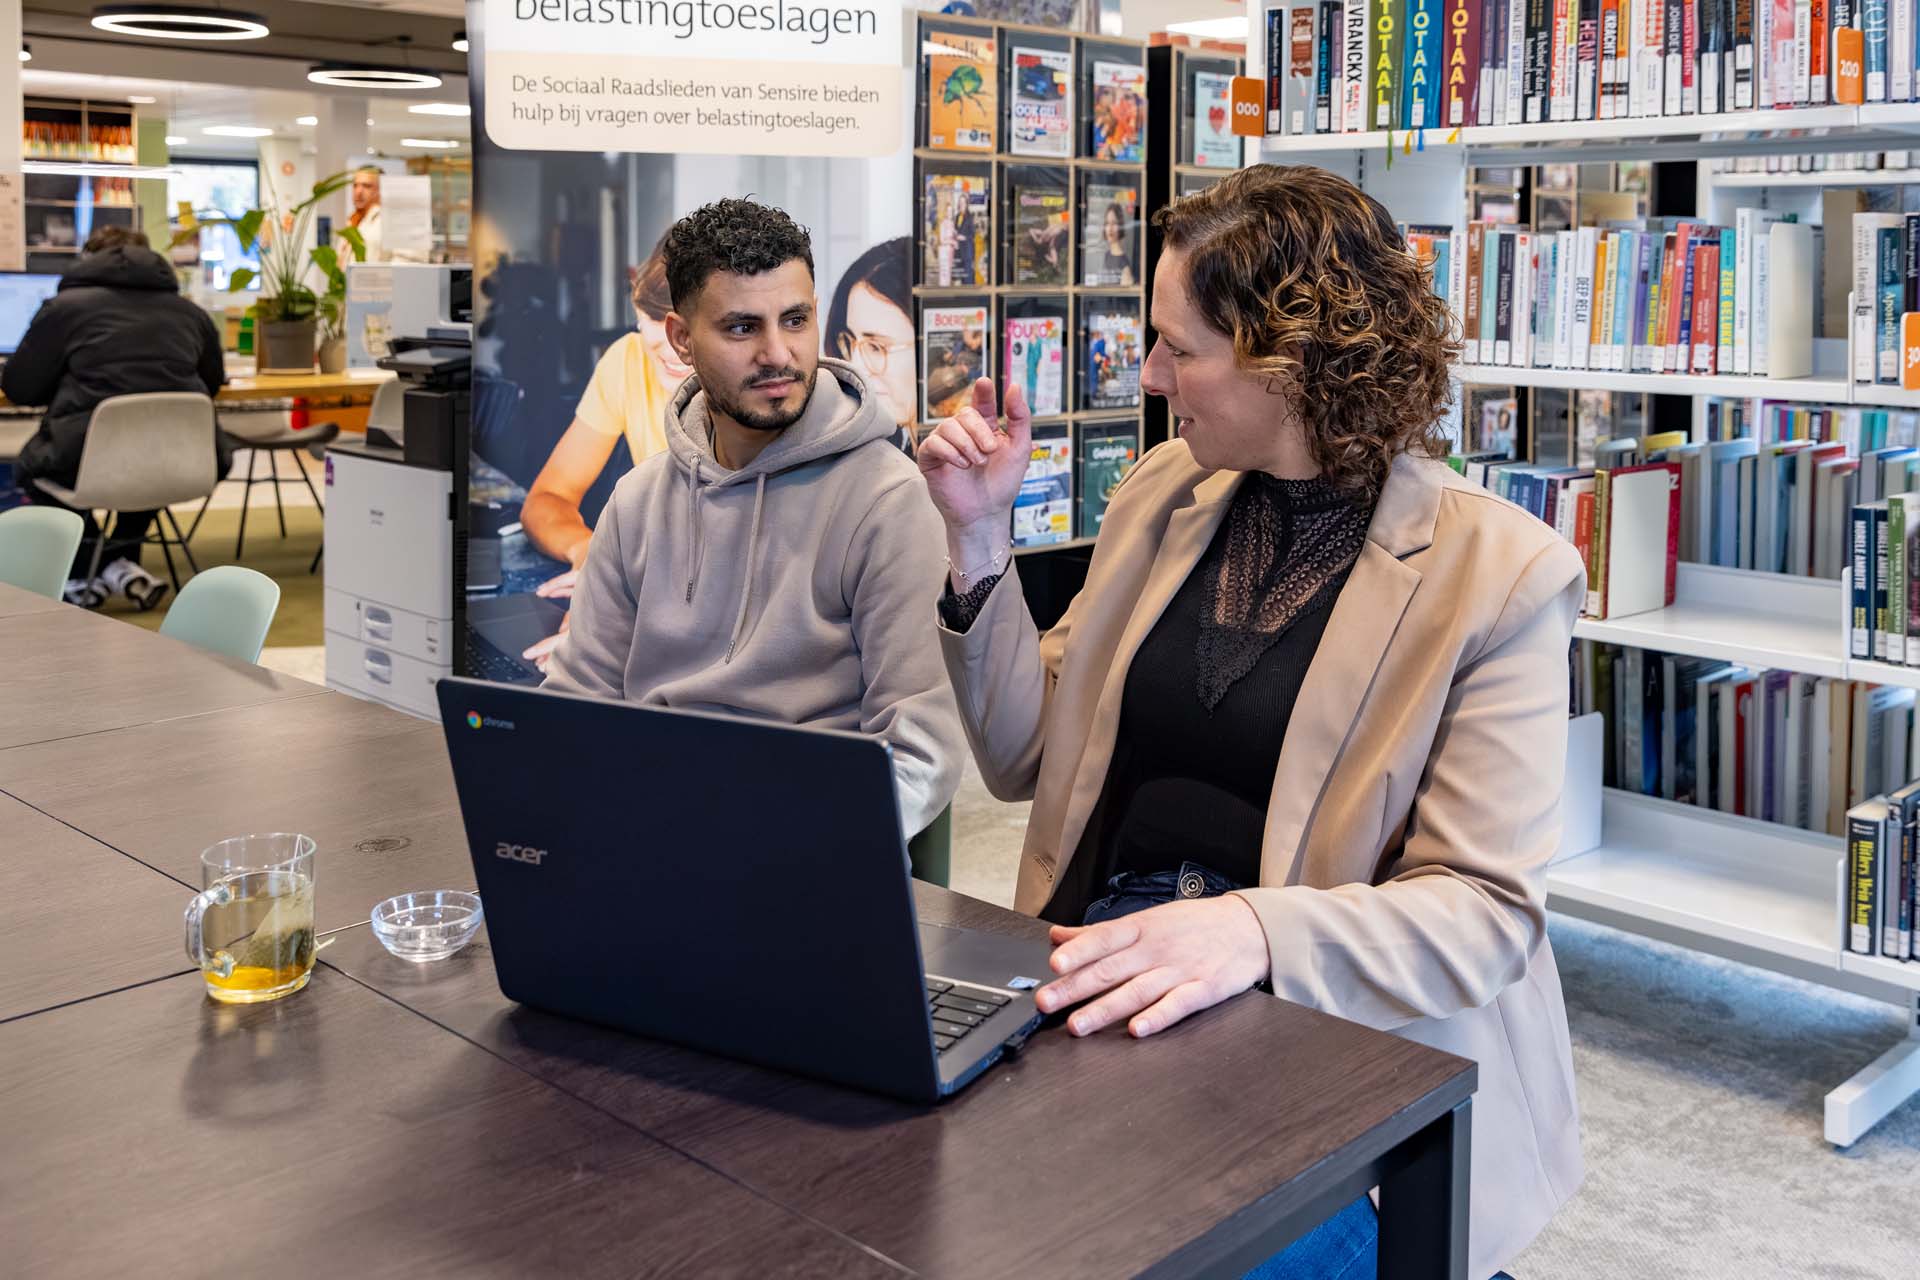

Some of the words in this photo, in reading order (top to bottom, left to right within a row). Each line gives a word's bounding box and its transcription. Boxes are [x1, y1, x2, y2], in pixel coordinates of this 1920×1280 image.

[1669, 6, 1681, 32] JOHN
[1347, 7, 1364, 83] VRANCKX
[1578, 20, 1598, 66] HENN
[1603, 15, 1618, 55] KRACHT
[1669, 33, 1680, 47] DE
[1376, 0, 1394, 104] TOTAAL
[1839, 59, 1859, 78] 200
[512, 75, 537, 93] De
[543, 76, 606, 95] Sociaal
[611, 79, 717, 100] Raadslieden
[721, 85, 754, 99] van
[758, 83, 819, 102] Sensire
[824, 85, 880, 104] bieden
[512, 102, 554, 126] hulp
[559, 104, 581, 127] bij
[586, 109, 649, 128] vragen
[653, 110, 692, 124] over
[696, 107, 862, 135] belastingtoeslagen.
[1236, 102, 1261, 117] 000
[1500, 273, 1511, 300] Human
[1575, 276, 1590, 297] DEEP
[1498, 301, 1510, 326] Design
[1574, 299, 1589, 323] RELAX
[1854, 520, 1867, 554] MORELE
[1854, 555, 1867, 591] AMBITIE
[483, 716, 515, 730] chrome
[496, 842, 548, 865] acer
[1858, 840, 1875, 875] Hitlers
[1857, 878, 1874, 901] Mein
[1856, 903, 1873, 926] Kam
